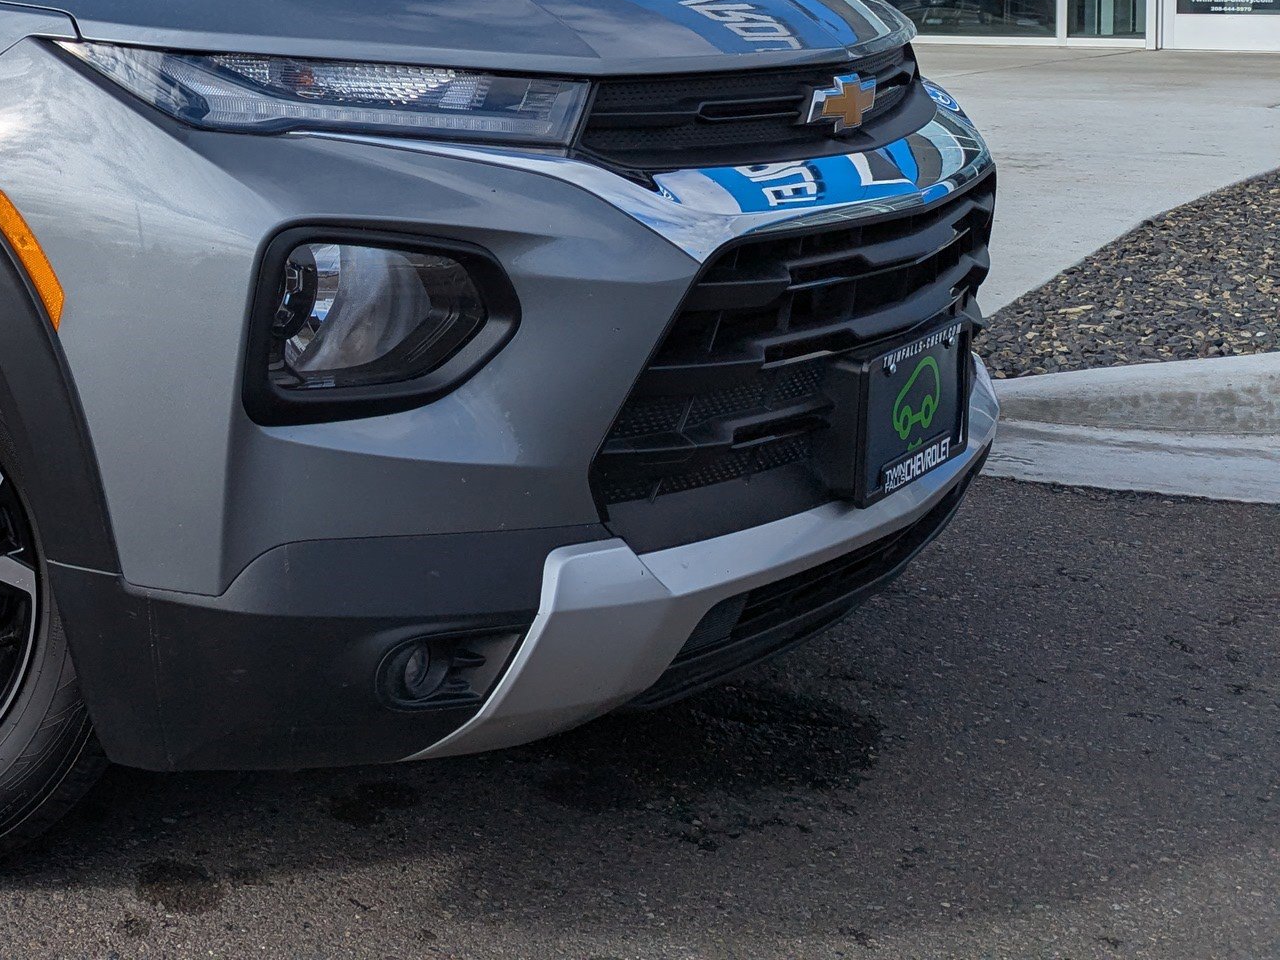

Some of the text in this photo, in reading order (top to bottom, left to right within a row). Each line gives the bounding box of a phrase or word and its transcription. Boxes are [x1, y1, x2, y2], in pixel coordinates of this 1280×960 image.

[883, 323, 962, 369] TWINFALLS-CHEVY.COM
[885, 464, 906, 483] TWIN
[904, 436, 952, 482] CHEVROLET
[884, 473, 906, 494] FALLS
